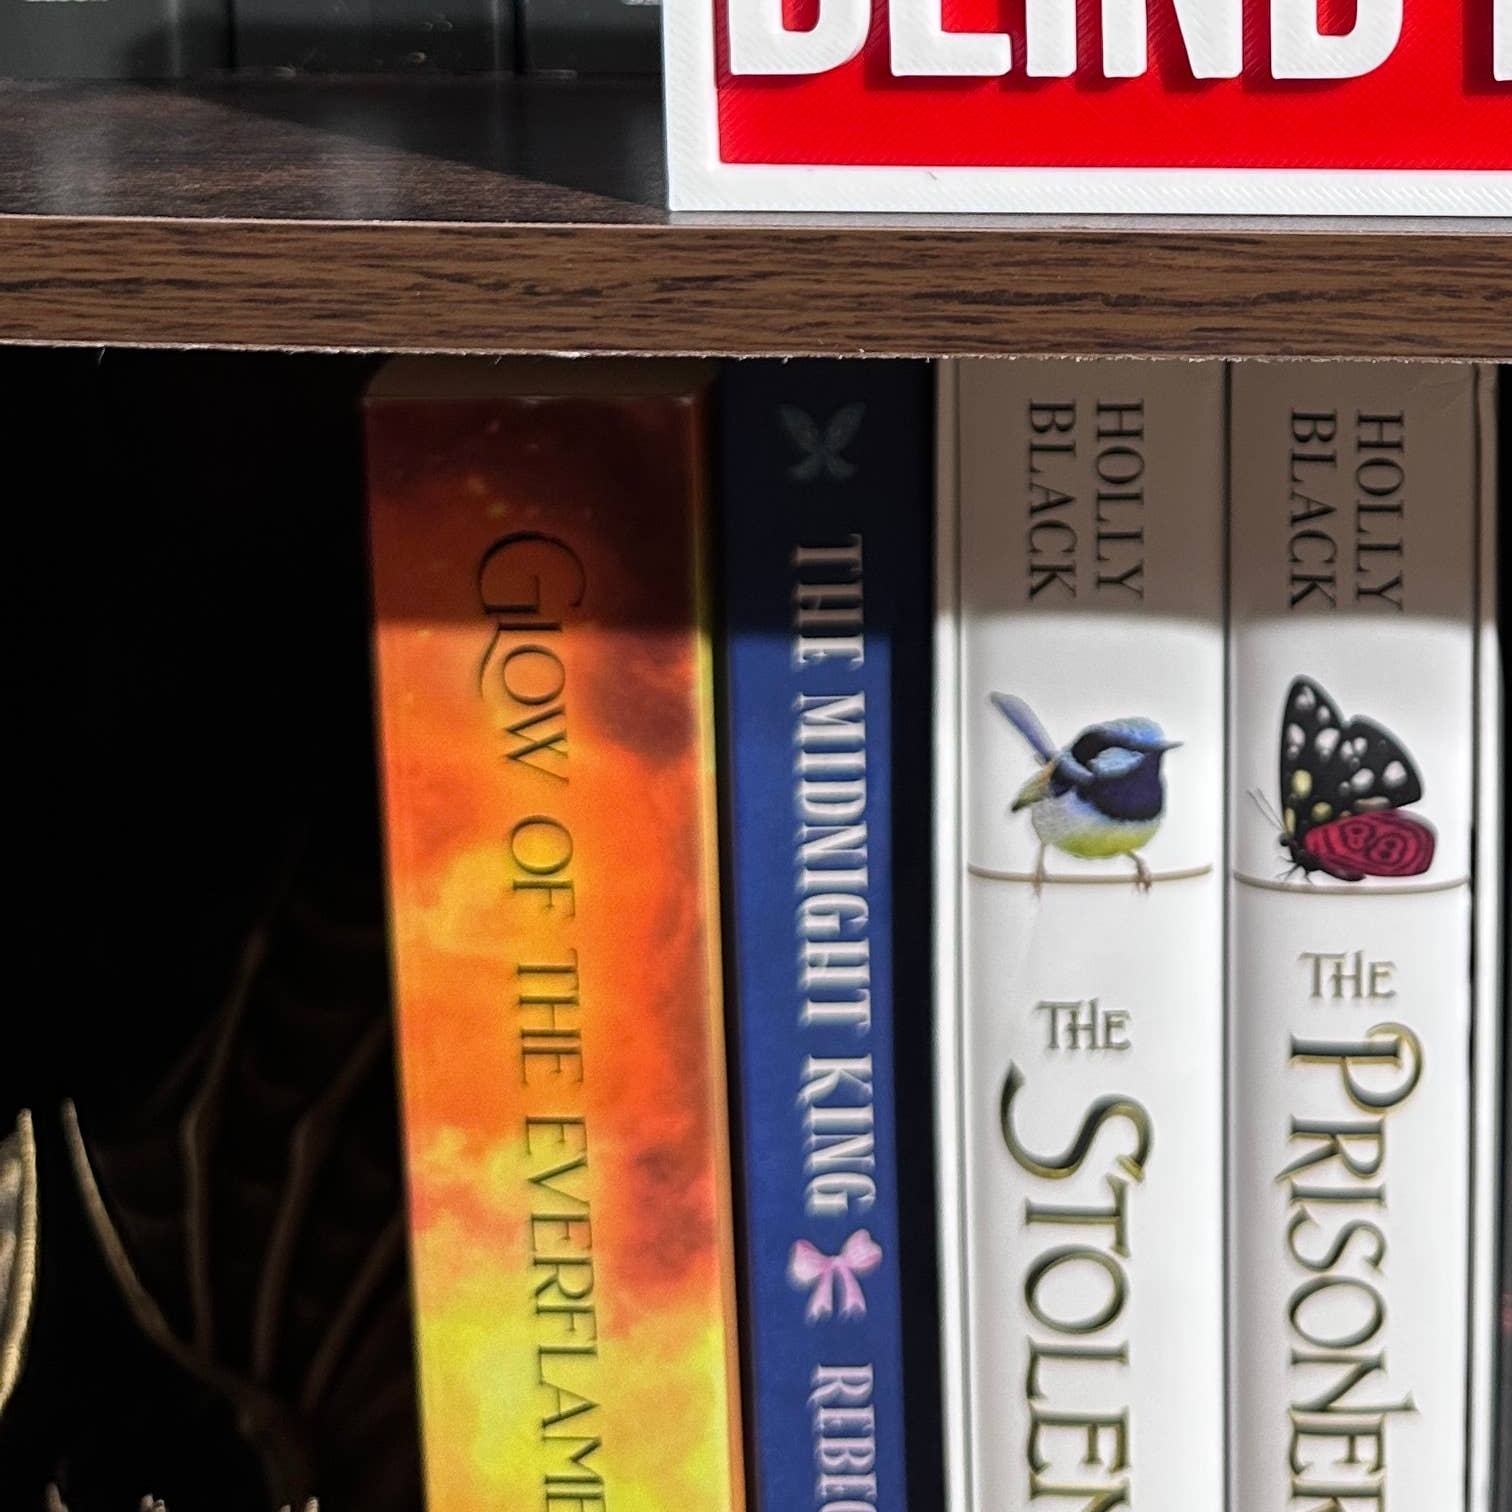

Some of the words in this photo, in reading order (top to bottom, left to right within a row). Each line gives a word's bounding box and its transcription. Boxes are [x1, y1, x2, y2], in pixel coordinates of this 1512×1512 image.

[1028, 398, 1077, 600] BLACK
[1095, 398, 1145, 600] HOLLY
[1289, 408, 1338, 610] BLACK
[1355, 410, 1405, 611] HOLLY
[477, 530, 586, 786] GLOW
[792, 533, 865, 672] THE
[508, 814, 577, 921] OF
[793, 693, 872, 1038] MIDNIGHT
[515, 948, 584, 1088] THE
[1034, 998, 1133, 1051] THE
[1300, 951, 1397, 1000] THE
[795, 1053, 876, 1217] KING
